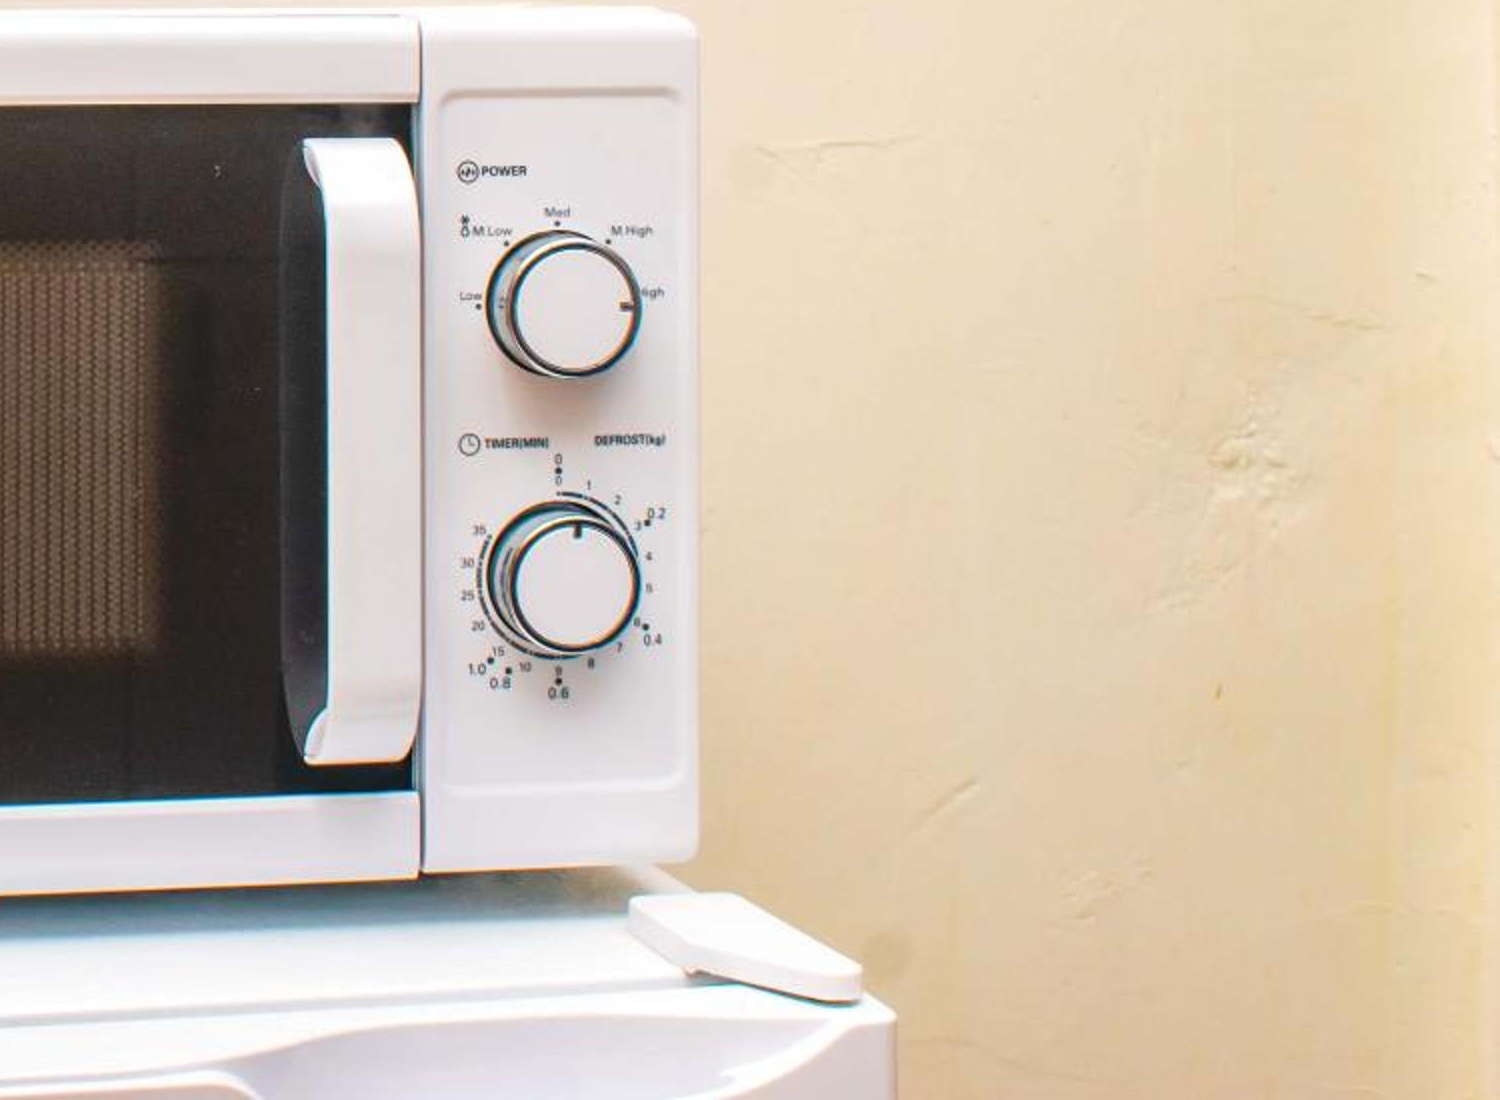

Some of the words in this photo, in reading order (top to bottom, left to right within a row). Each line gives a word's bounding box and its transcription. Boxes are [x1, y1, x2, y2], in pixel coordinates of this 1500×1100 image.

[481, 165, 527, 177] POWER
[544, 205, 571, 217] Med
[459, 291, 483, 301] Low
[594, 434, 666, 447] DEFROST(kg)
[554, 453, 563, 466] 0
[555, 475, 563, 486] 0
[614, 494, 622, 505] 2
[647, 507, 666, 520] 0.2
[473, 524, 487, 536] 35
[633, 519, 641, 531] 3
[645, 551, 653, 561] 4
[461, 557, 475, 568] 30
[461, 589, 475, 601] 25
[471, 620, 485, 632] 20
[643, 633, 663, 647] 0.4
[491, 646, 505, 657] 15
[468, 663, 487, 675] 1.0
[519, 661, 532, 673] 10
[587, 657, 595, 669] 8
[489, 677, 511, 690] 0.8
[547, 686, 570, 700] 0.6
